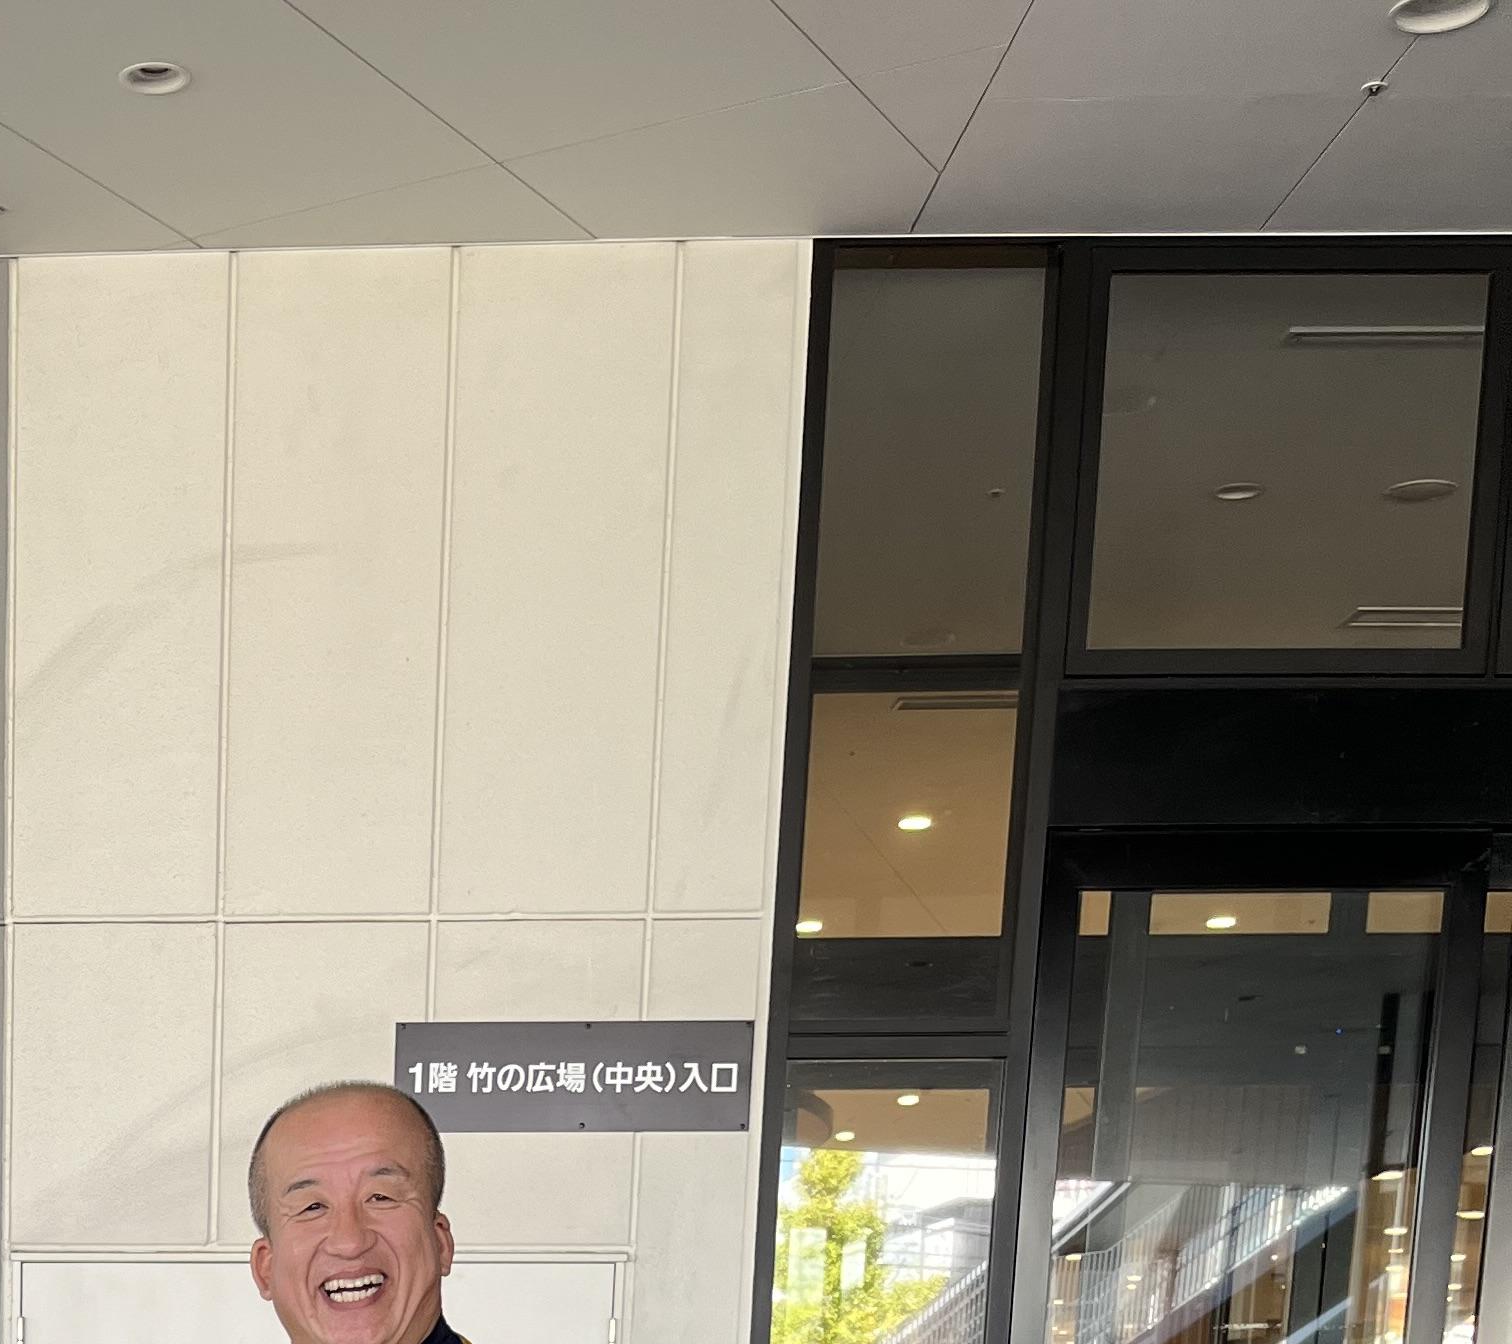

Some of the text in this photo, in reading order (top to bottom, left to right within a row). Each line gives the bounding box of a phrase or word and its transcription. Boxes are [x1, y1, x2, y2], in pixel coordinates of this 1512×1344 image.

[409, 1061, 739, 1094] 1階 竹の広場（中央）入口
